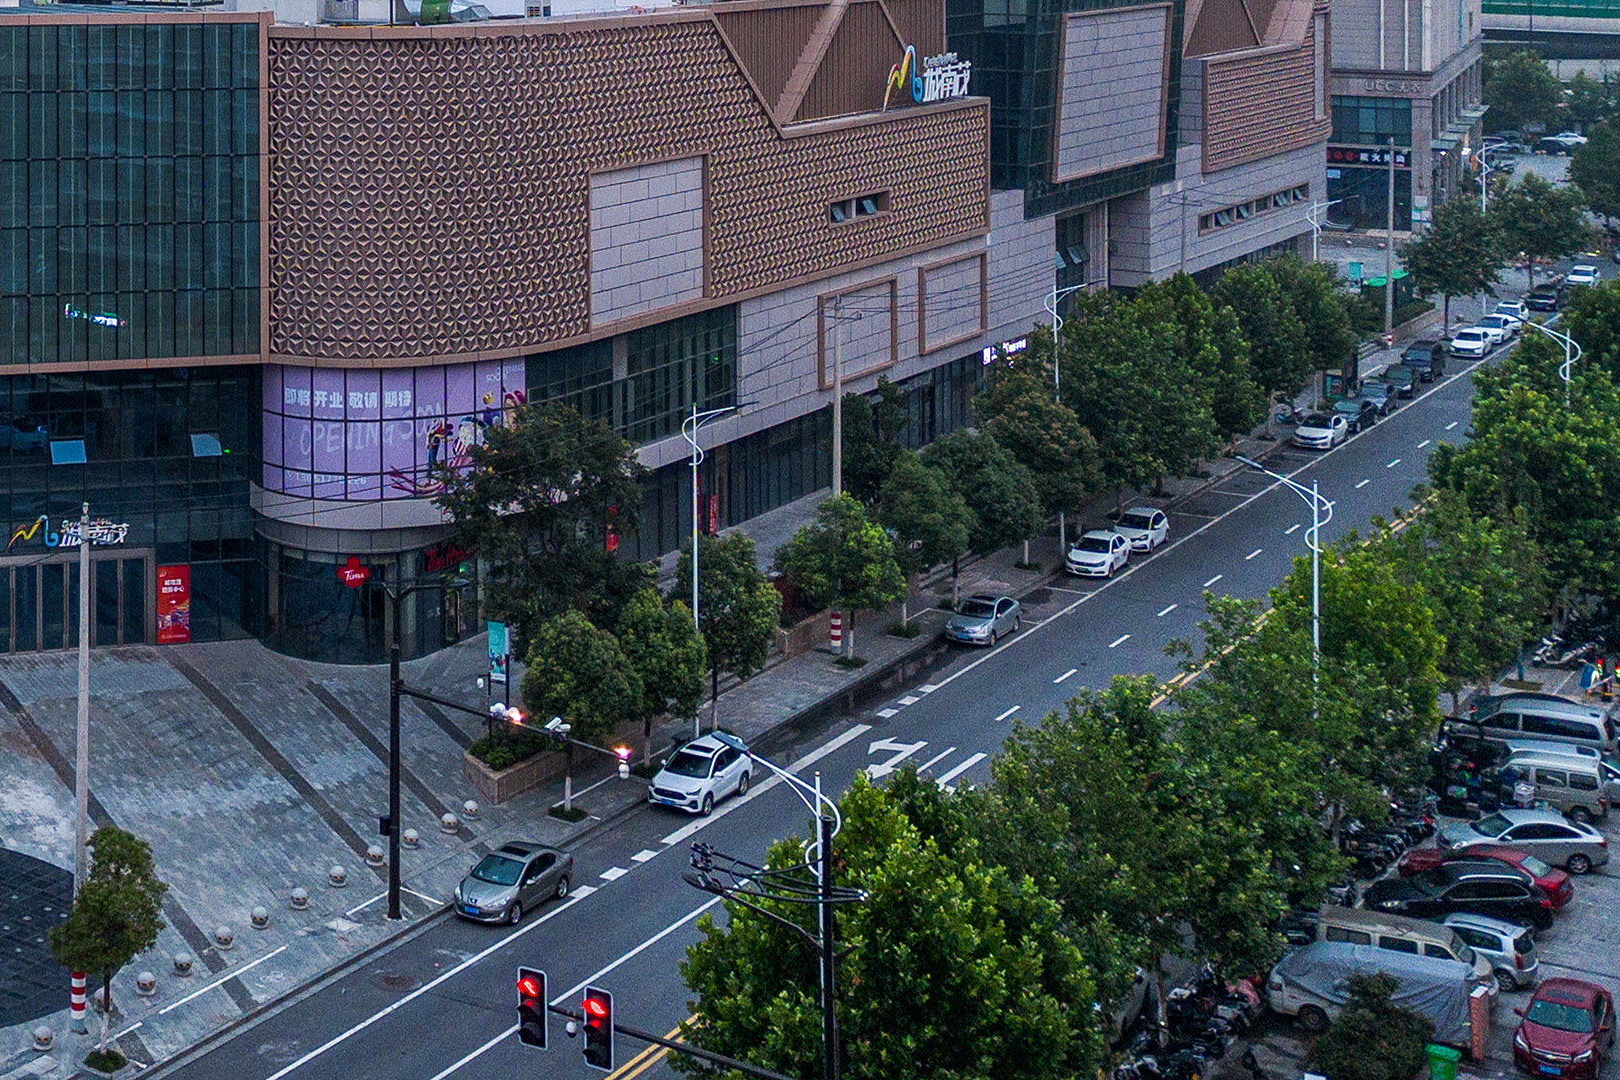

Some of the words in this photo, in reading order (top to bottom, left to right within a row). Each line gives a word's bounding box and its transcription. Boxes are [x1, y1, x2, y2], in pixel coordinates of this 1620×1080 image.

[922, 60, 972, 103] 城南茂
[343, 569, 366, 582] Tims
